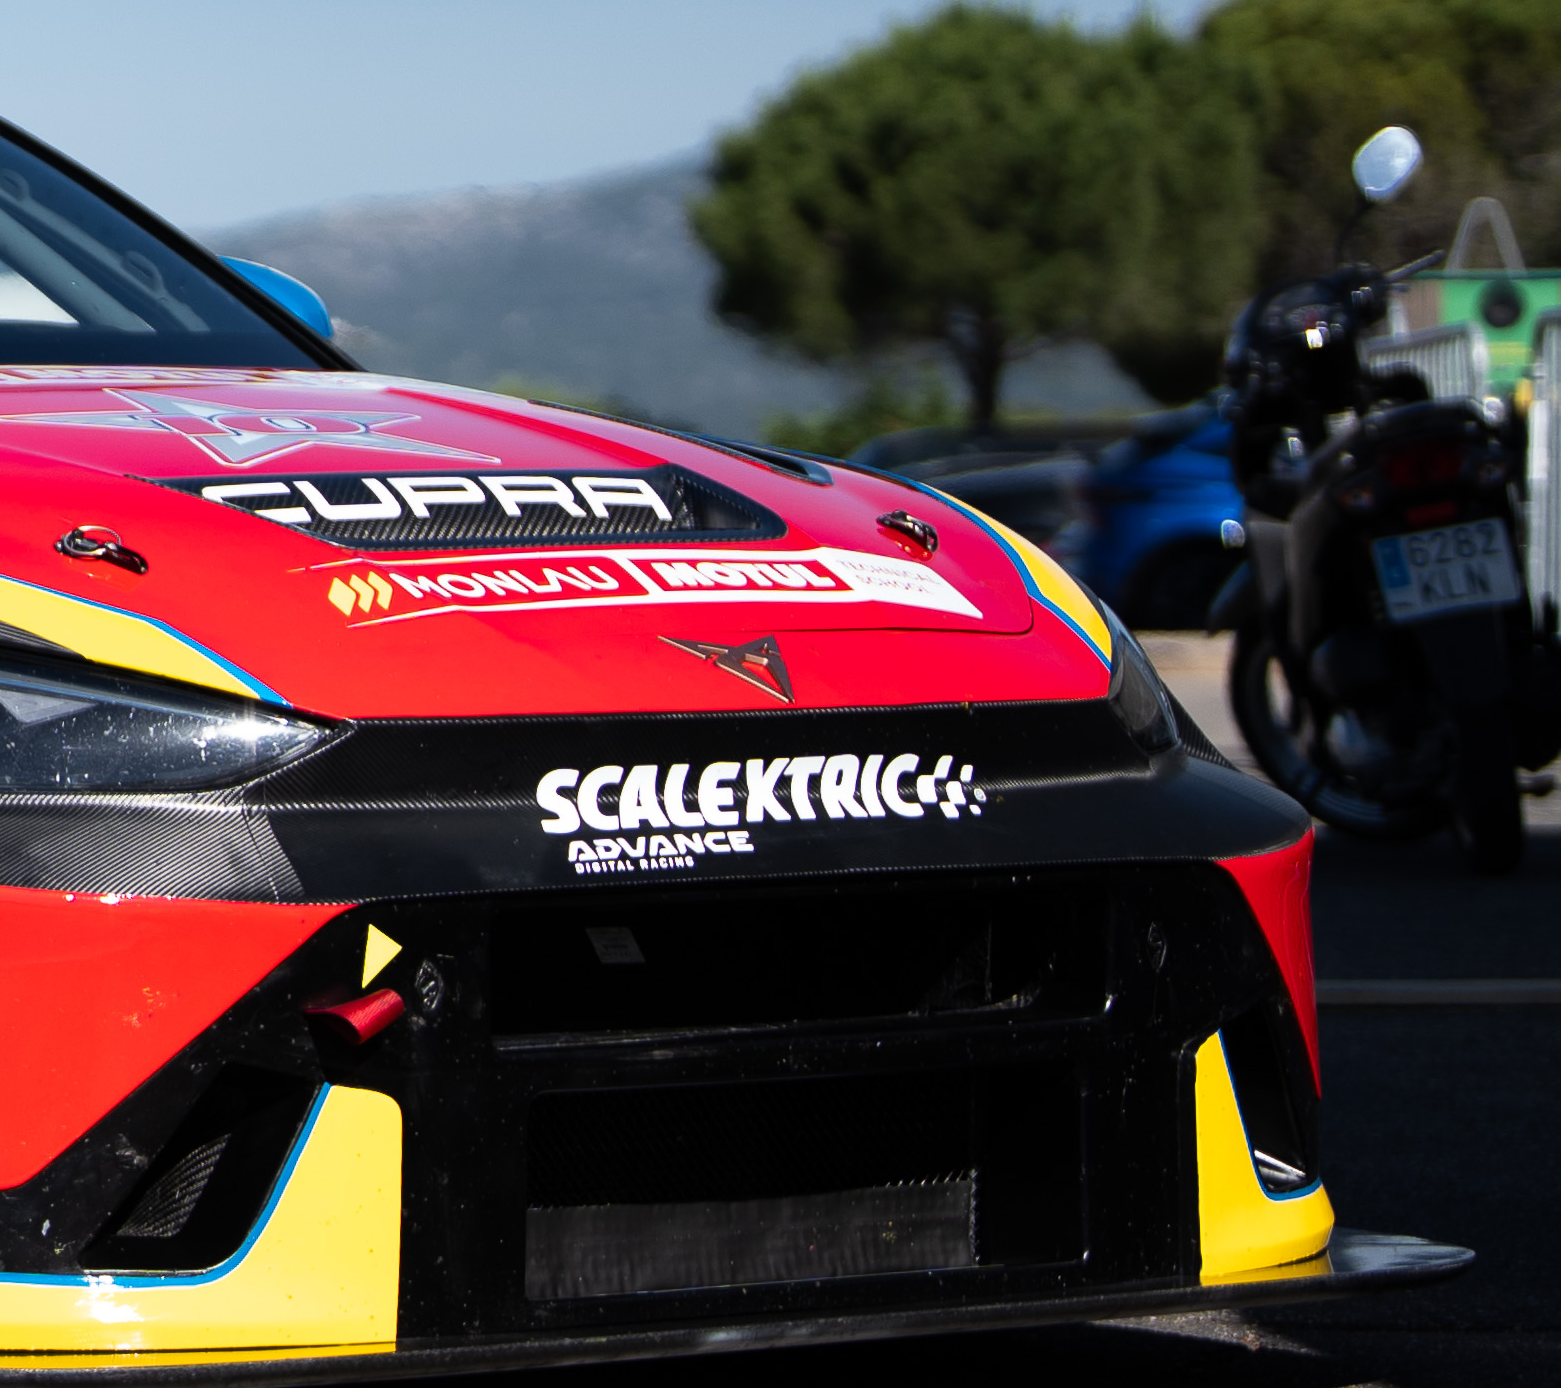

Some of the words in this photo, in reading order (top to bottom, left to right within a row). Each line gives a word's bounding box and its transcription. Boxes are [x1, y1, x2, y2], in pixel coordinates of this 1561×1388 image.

[201, 475, 674, 524] CUPRA
[390, 564, 619, 599] MONLAU
[650, 560, 838, 589] MOTUL
[536, 753, 925, 835] SCALEXTRIC
[567, 830, 755, 862] ADVANCE
[574, 859, 634, 875] DIGITAL
[639, 855, 695, 871] RACING
